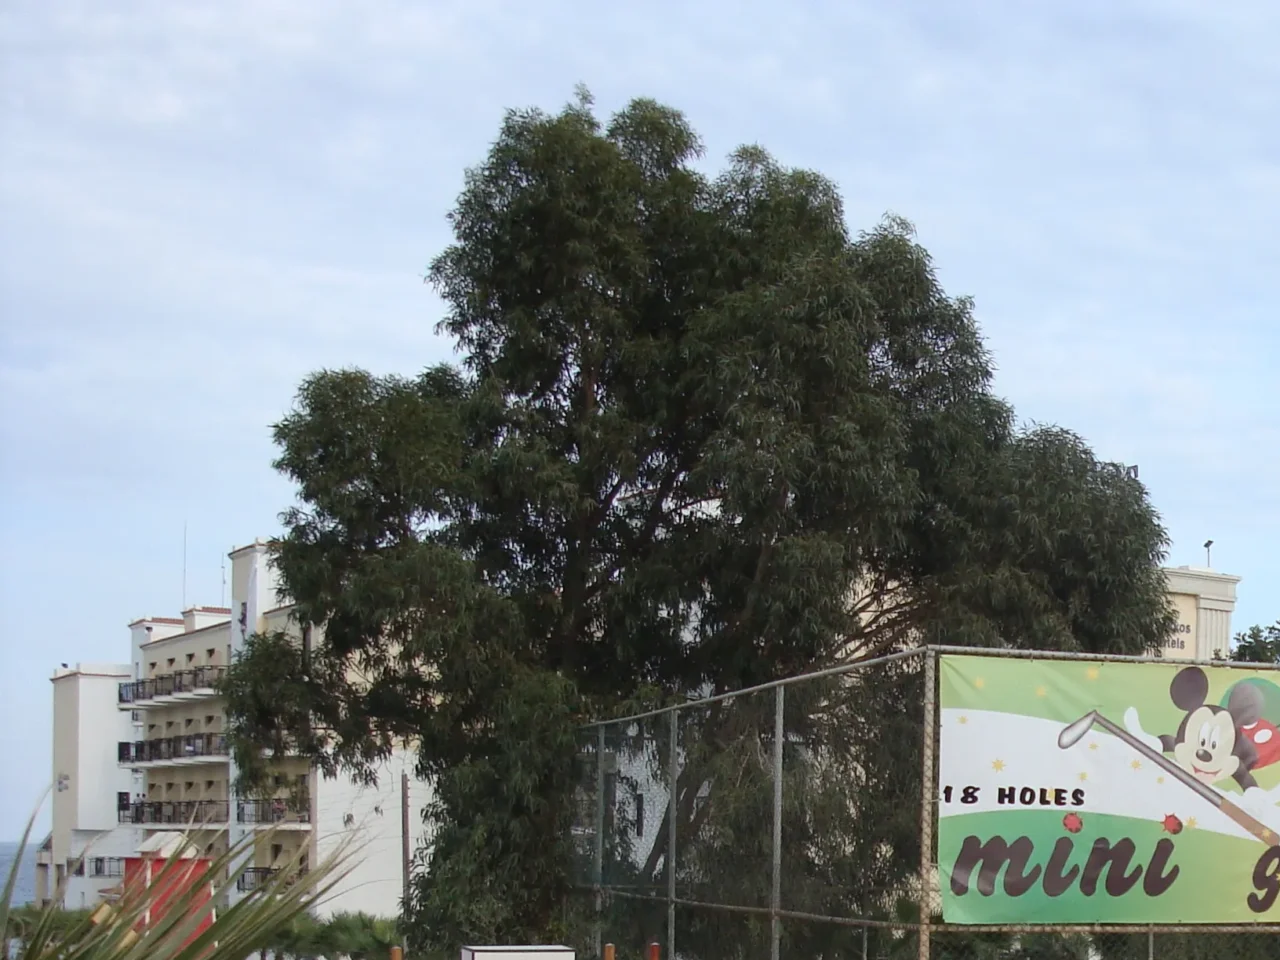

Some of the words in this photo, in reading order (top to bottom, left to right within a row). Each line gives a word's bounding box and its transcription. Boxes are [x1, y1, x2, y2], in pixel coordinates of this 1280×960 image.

[943, 785, 980, 804] 18
[998, 787, 1085, 806] HOLES
[950, 813, 1181, 897] mini
